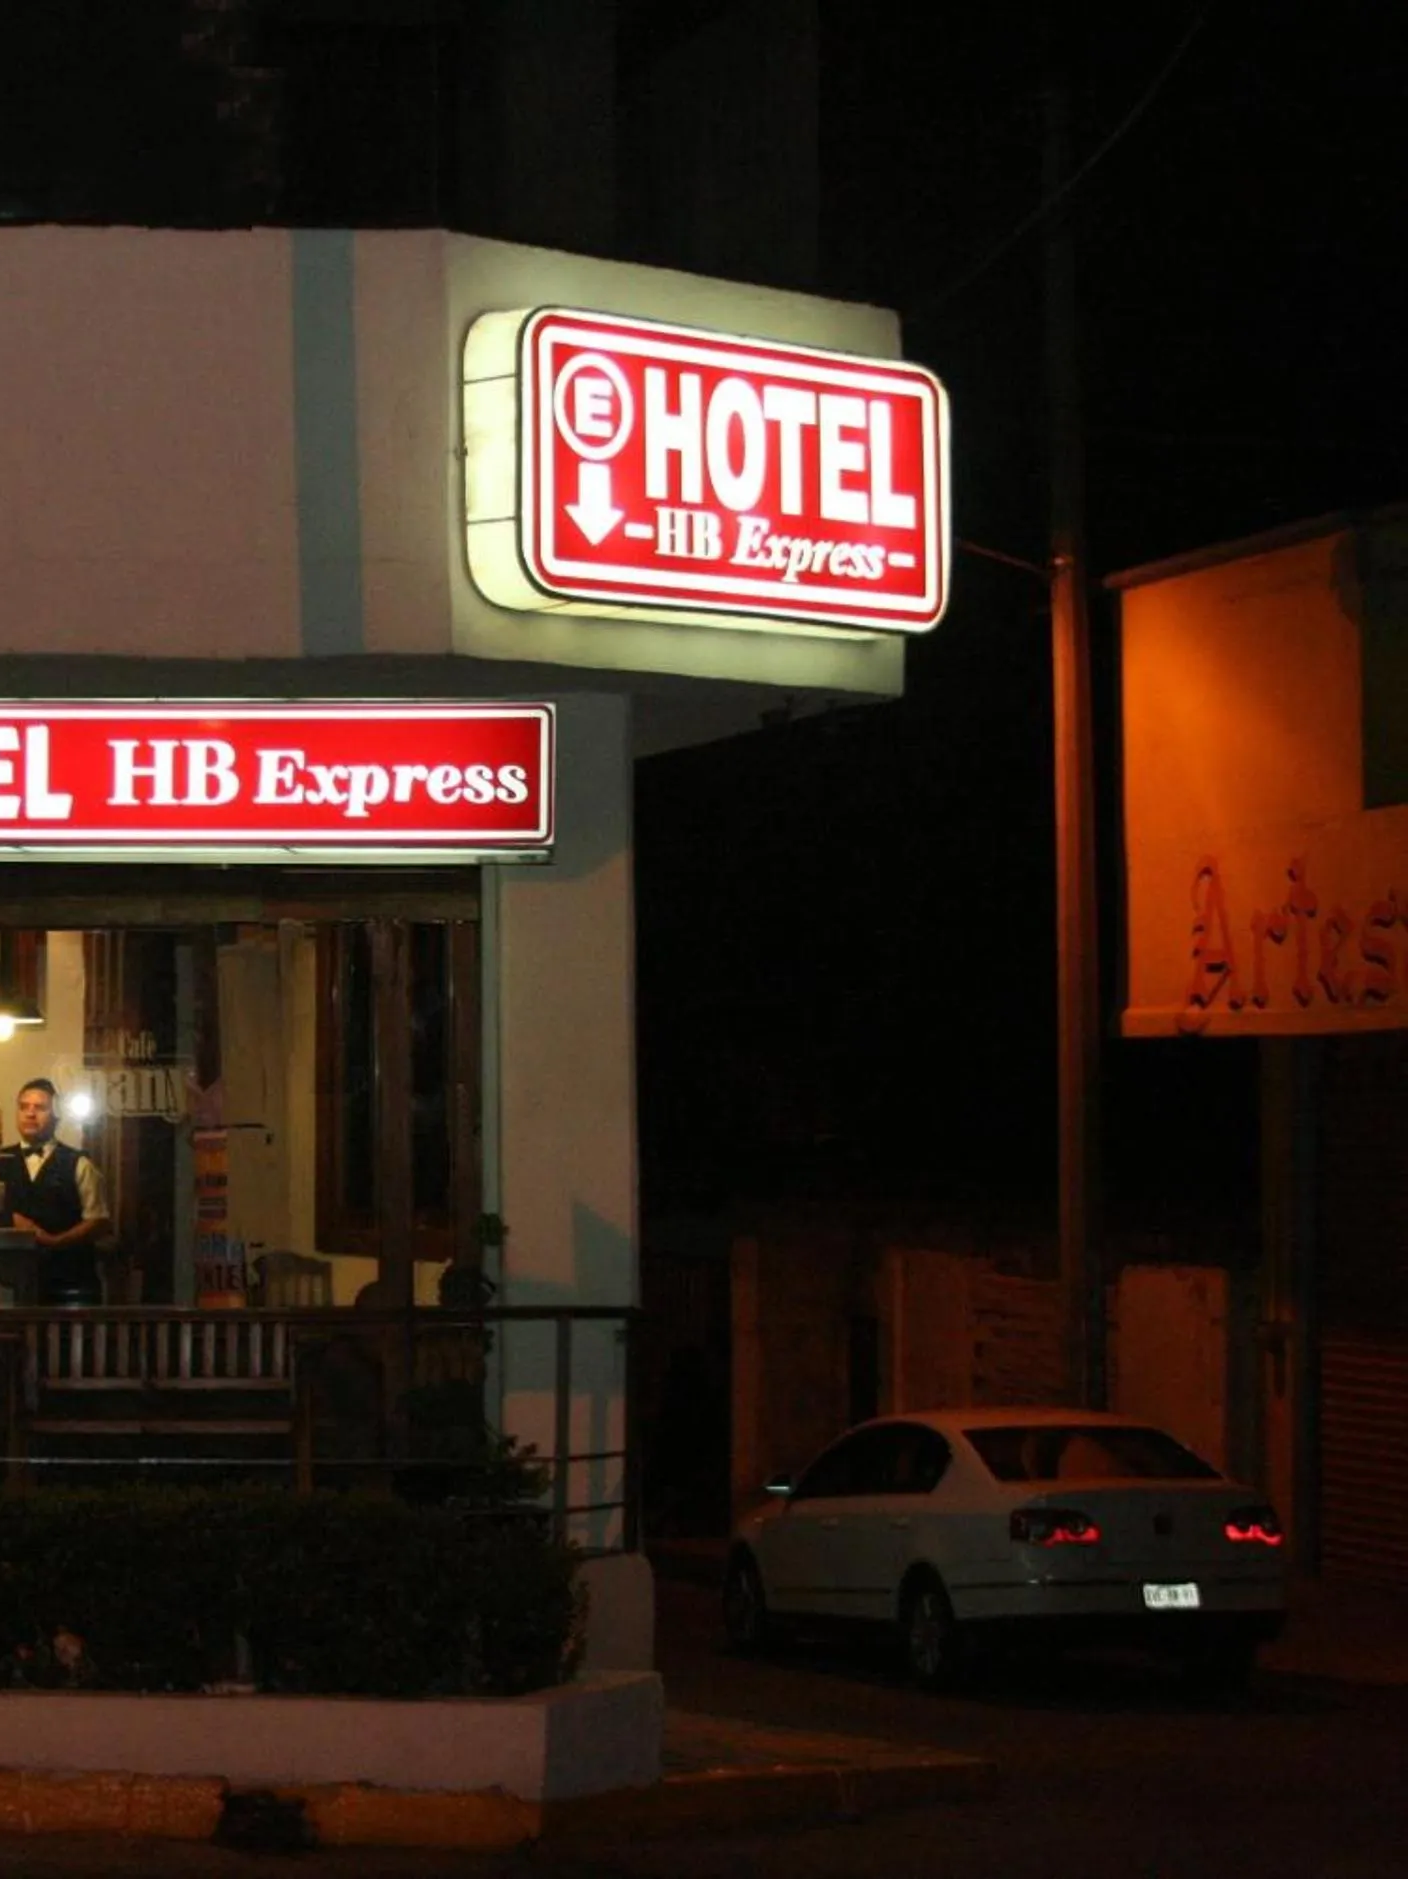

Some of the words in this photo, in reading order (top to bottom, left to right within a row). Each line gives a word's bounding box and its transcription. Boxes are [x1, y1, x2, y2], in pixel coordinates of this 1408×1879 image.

[645, 367, 916, 530] HOTEL
[107, 739, 239, 806] HB
[253, 748, 529, 816] Express
